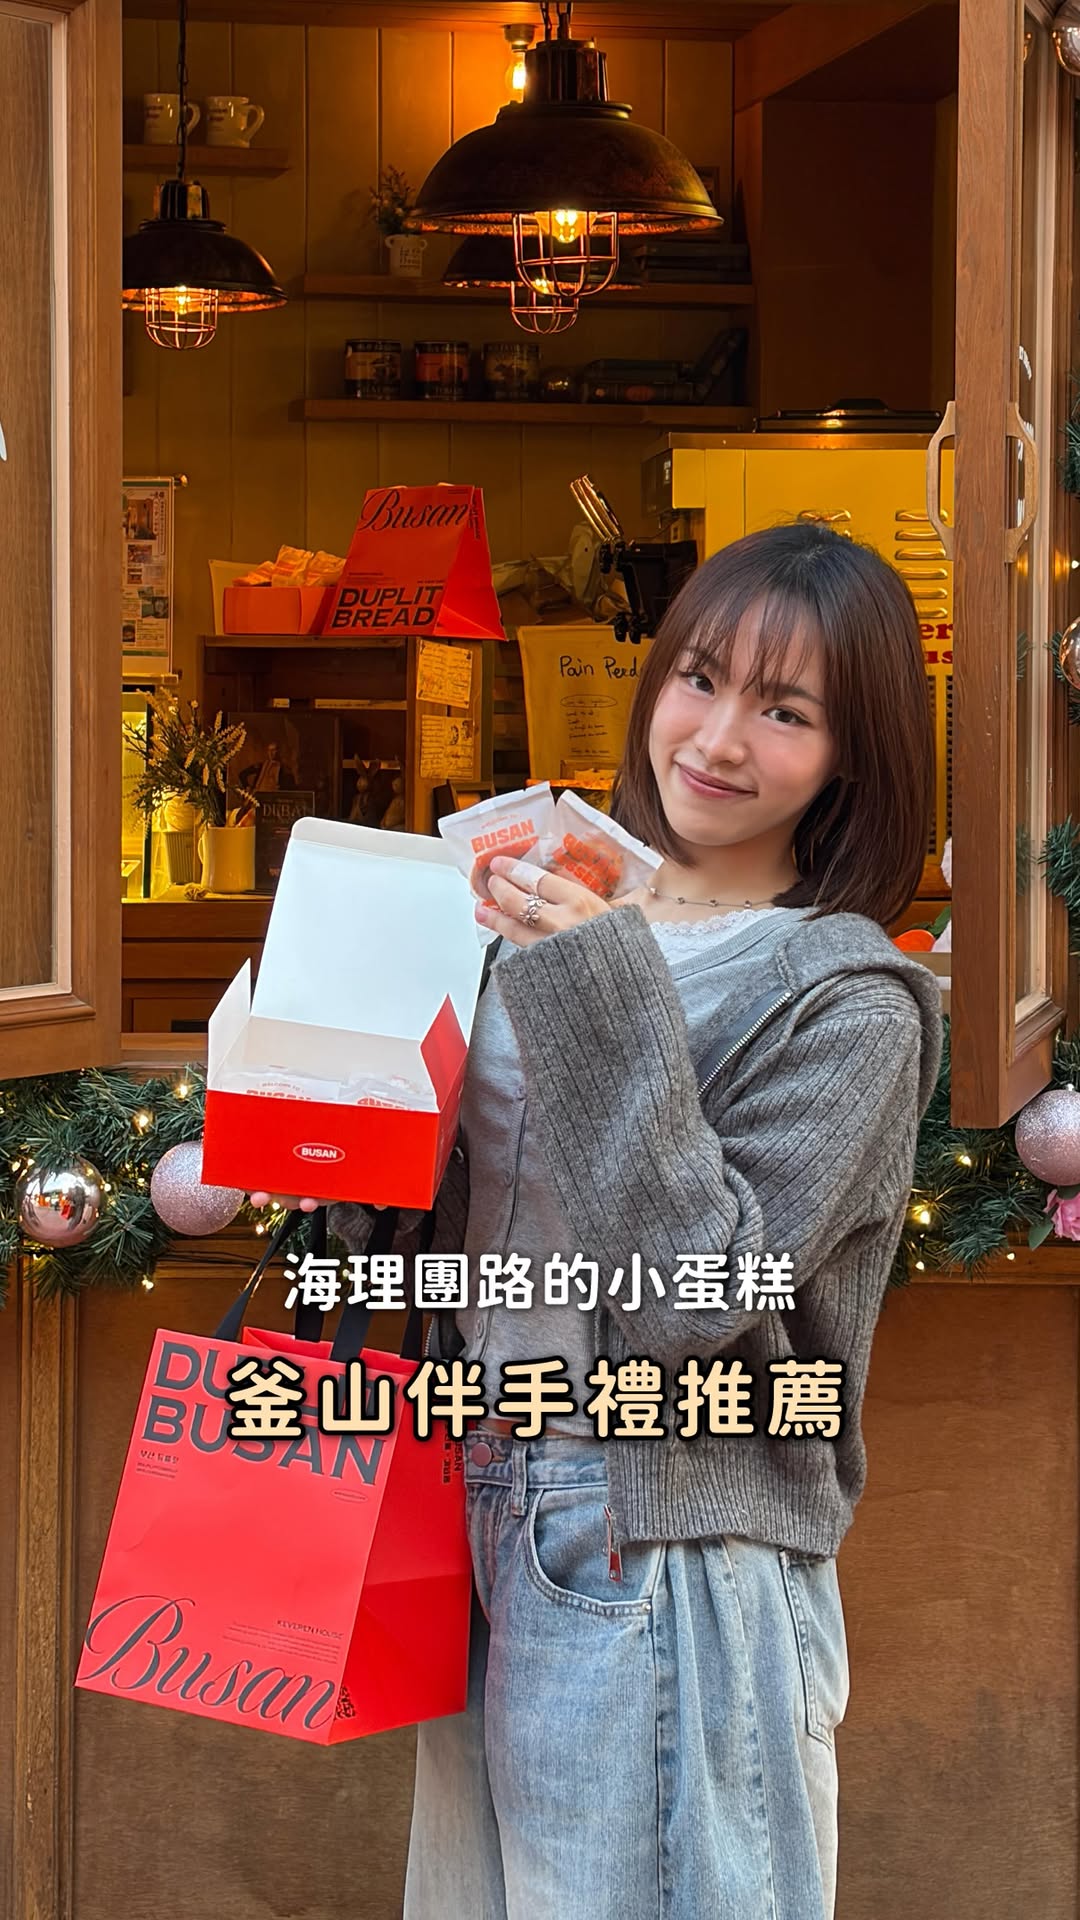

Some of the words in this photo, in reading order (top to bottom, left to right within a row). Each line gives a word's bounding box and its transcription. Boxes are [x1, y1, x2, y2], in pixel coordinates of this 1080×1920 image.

[358, 488, 469, 532] Busan
[338, 586, 443, 607] DUPLIT
[332, 607, 435, 628] BREAD
[559, 655, 594, 677] Pain
[471, 818, 535, 854] BUSAN
[301, 1146, 337, 1160] BUSAN
[78, 1595, 336, 1730] Busan
